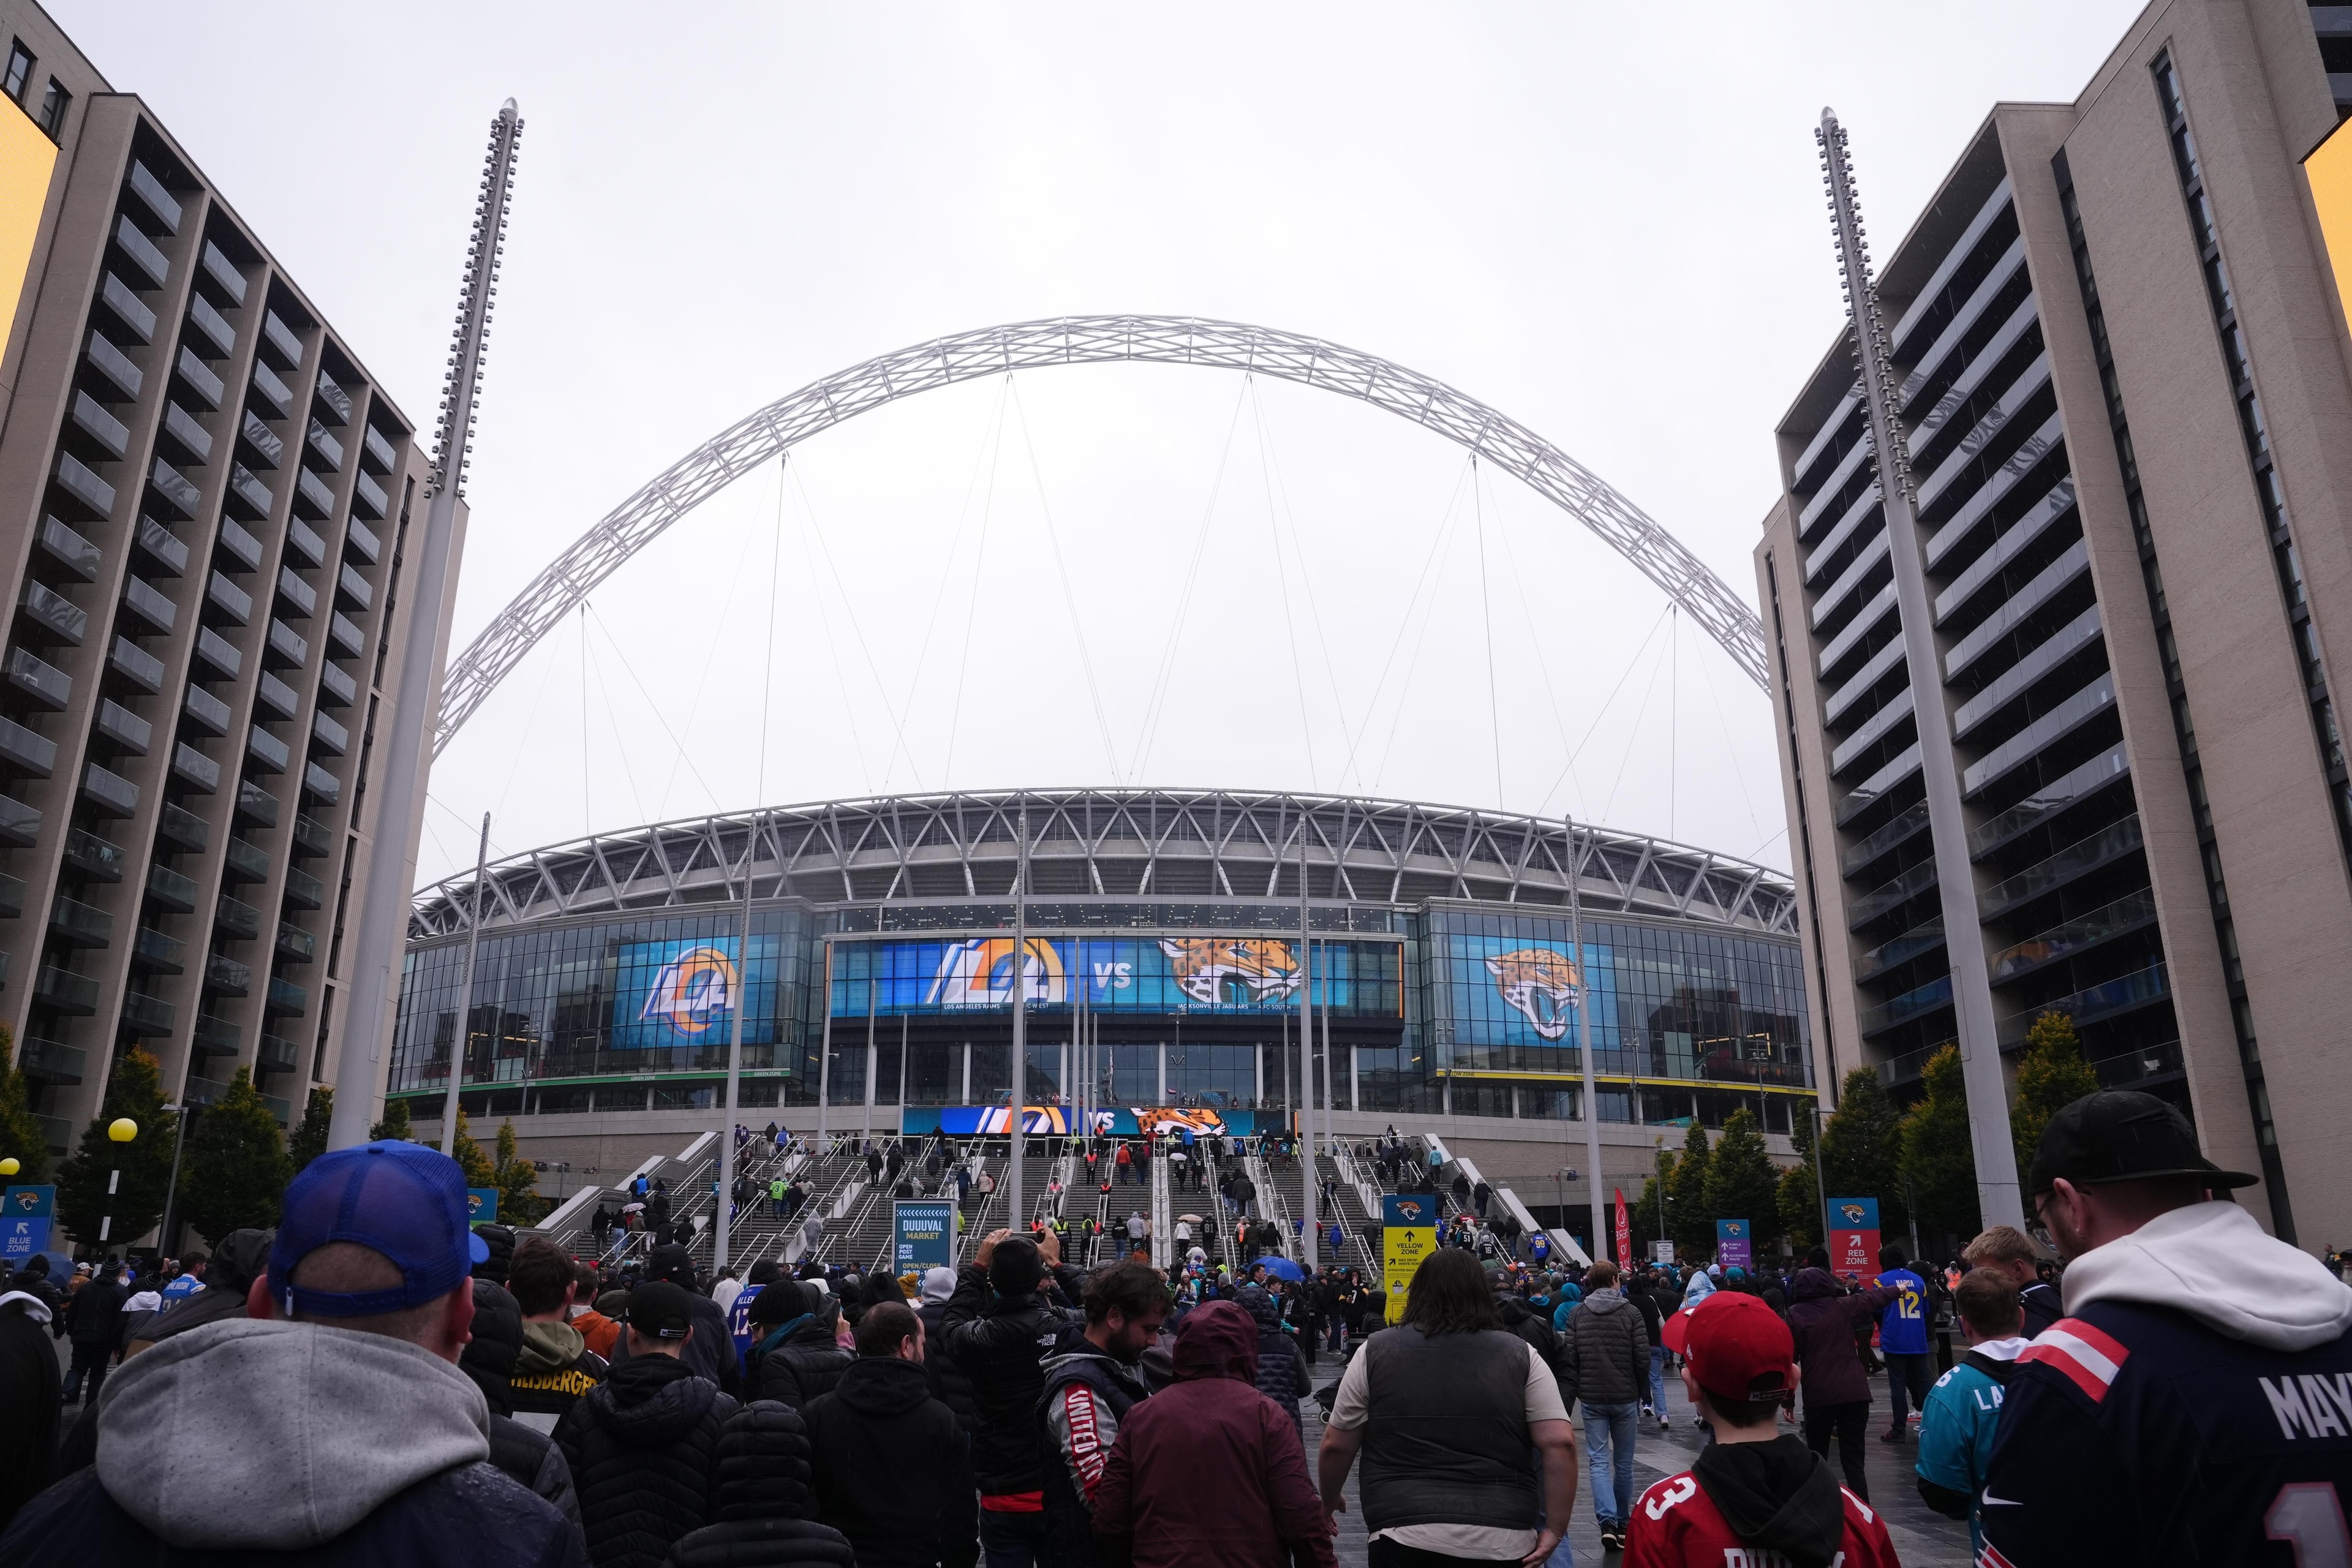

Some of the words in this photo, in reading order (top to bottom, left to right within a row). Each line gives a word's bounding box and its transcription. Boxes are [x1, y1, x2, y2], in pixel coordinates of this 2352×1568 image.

[1094, 963, 1132, 989] VS
[903, 1220, 943, 1231] DUUUVAL
[1204, 1223, 1214, 1234] 81
[1463, 1234, 1471, 1243] 51
[1535, 1240, 1545, 1248] 99
[737, 1295, 756, 1305] ALLEN
[1351, 1289, 1357, 1304] 7
[1898, 1291, 1921, 1319] 12
[733, 1308, 750, 1335] 17
[1936, 1366, 1961, 1387] 6
[1973, 1385, 2005, 1411] LA
[2257, 1372, 2352, 1440] MAY
[1068, 1390, 1098, 1454] UNITED
